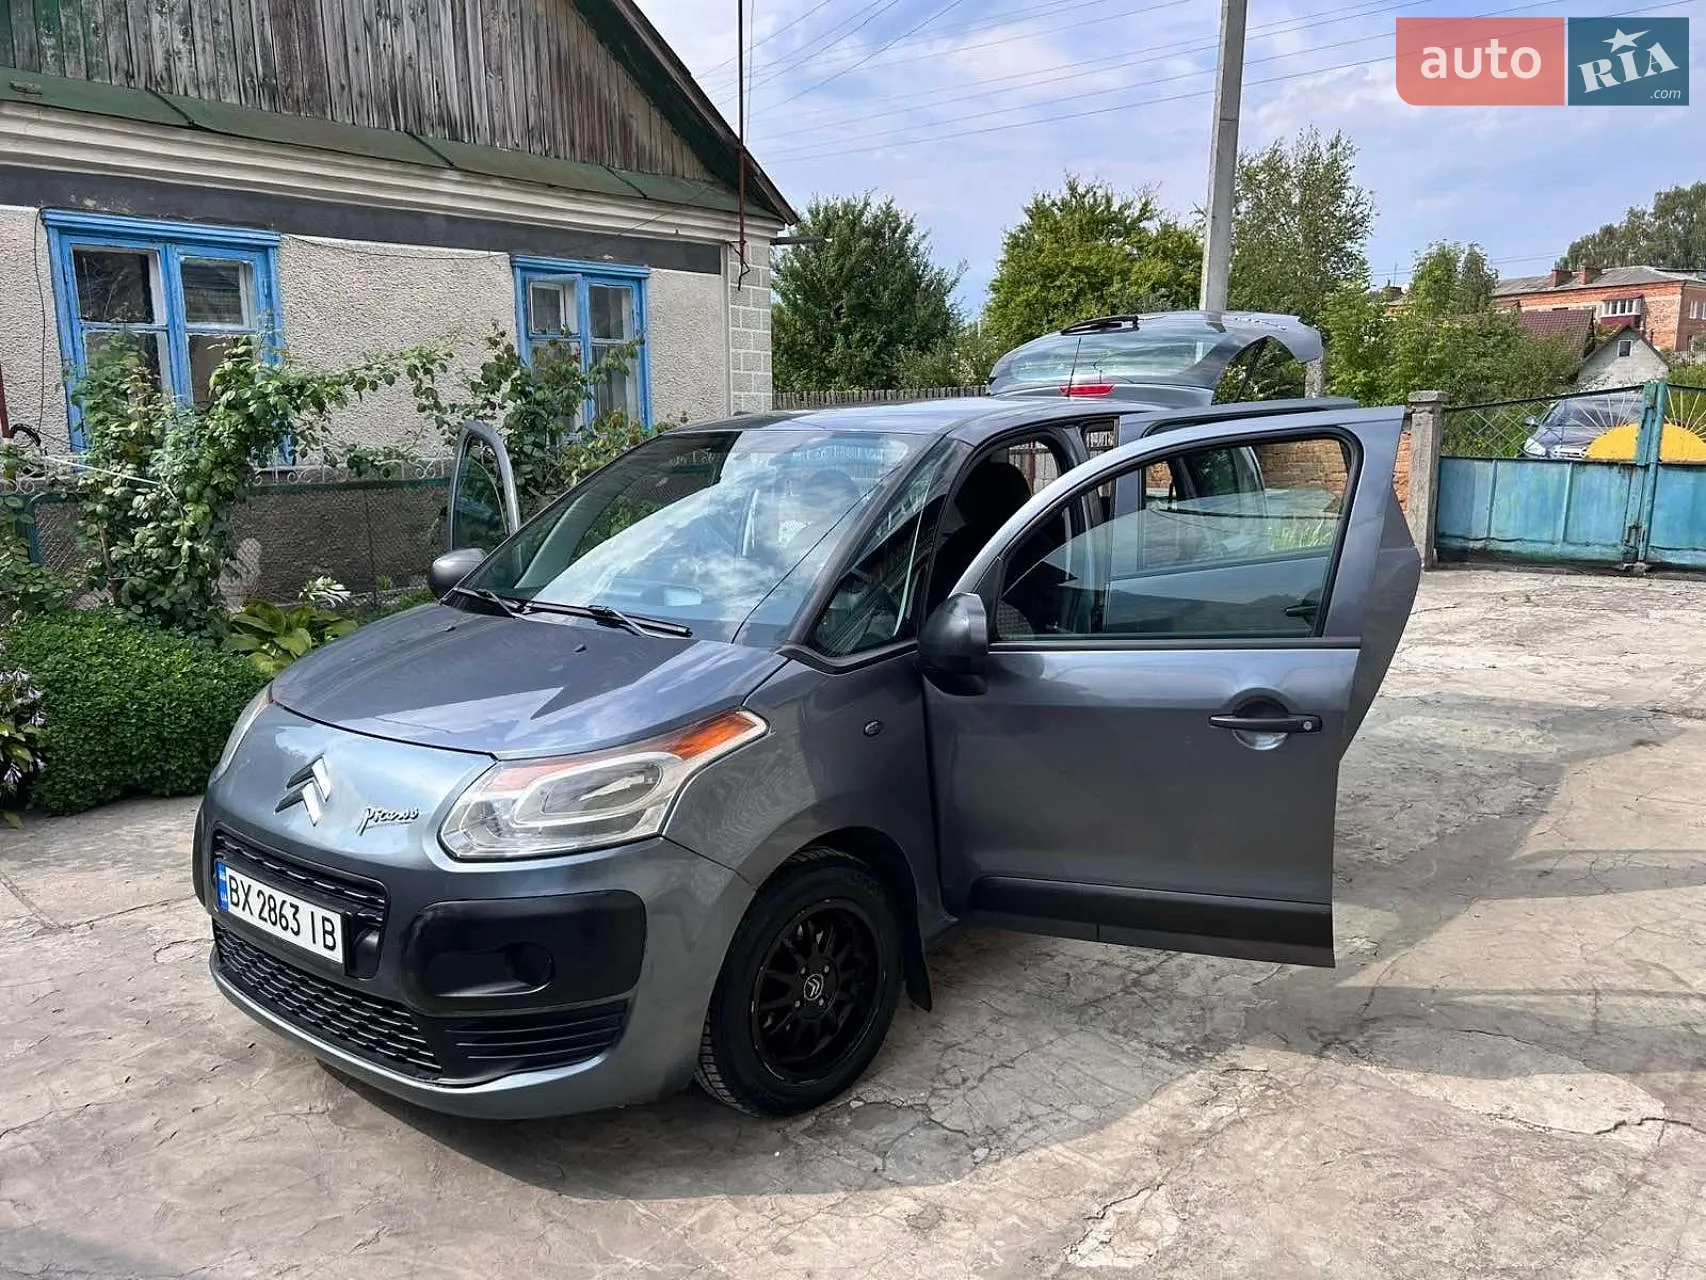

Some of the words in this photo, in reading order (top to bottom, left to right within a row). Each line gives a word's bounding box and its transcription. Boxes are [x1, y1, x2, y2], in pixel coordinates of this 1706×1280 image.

[228, 874, 255, 916] BX
[256, 889, 301, 937] 2863
[310, 911, 337, 951] IB
